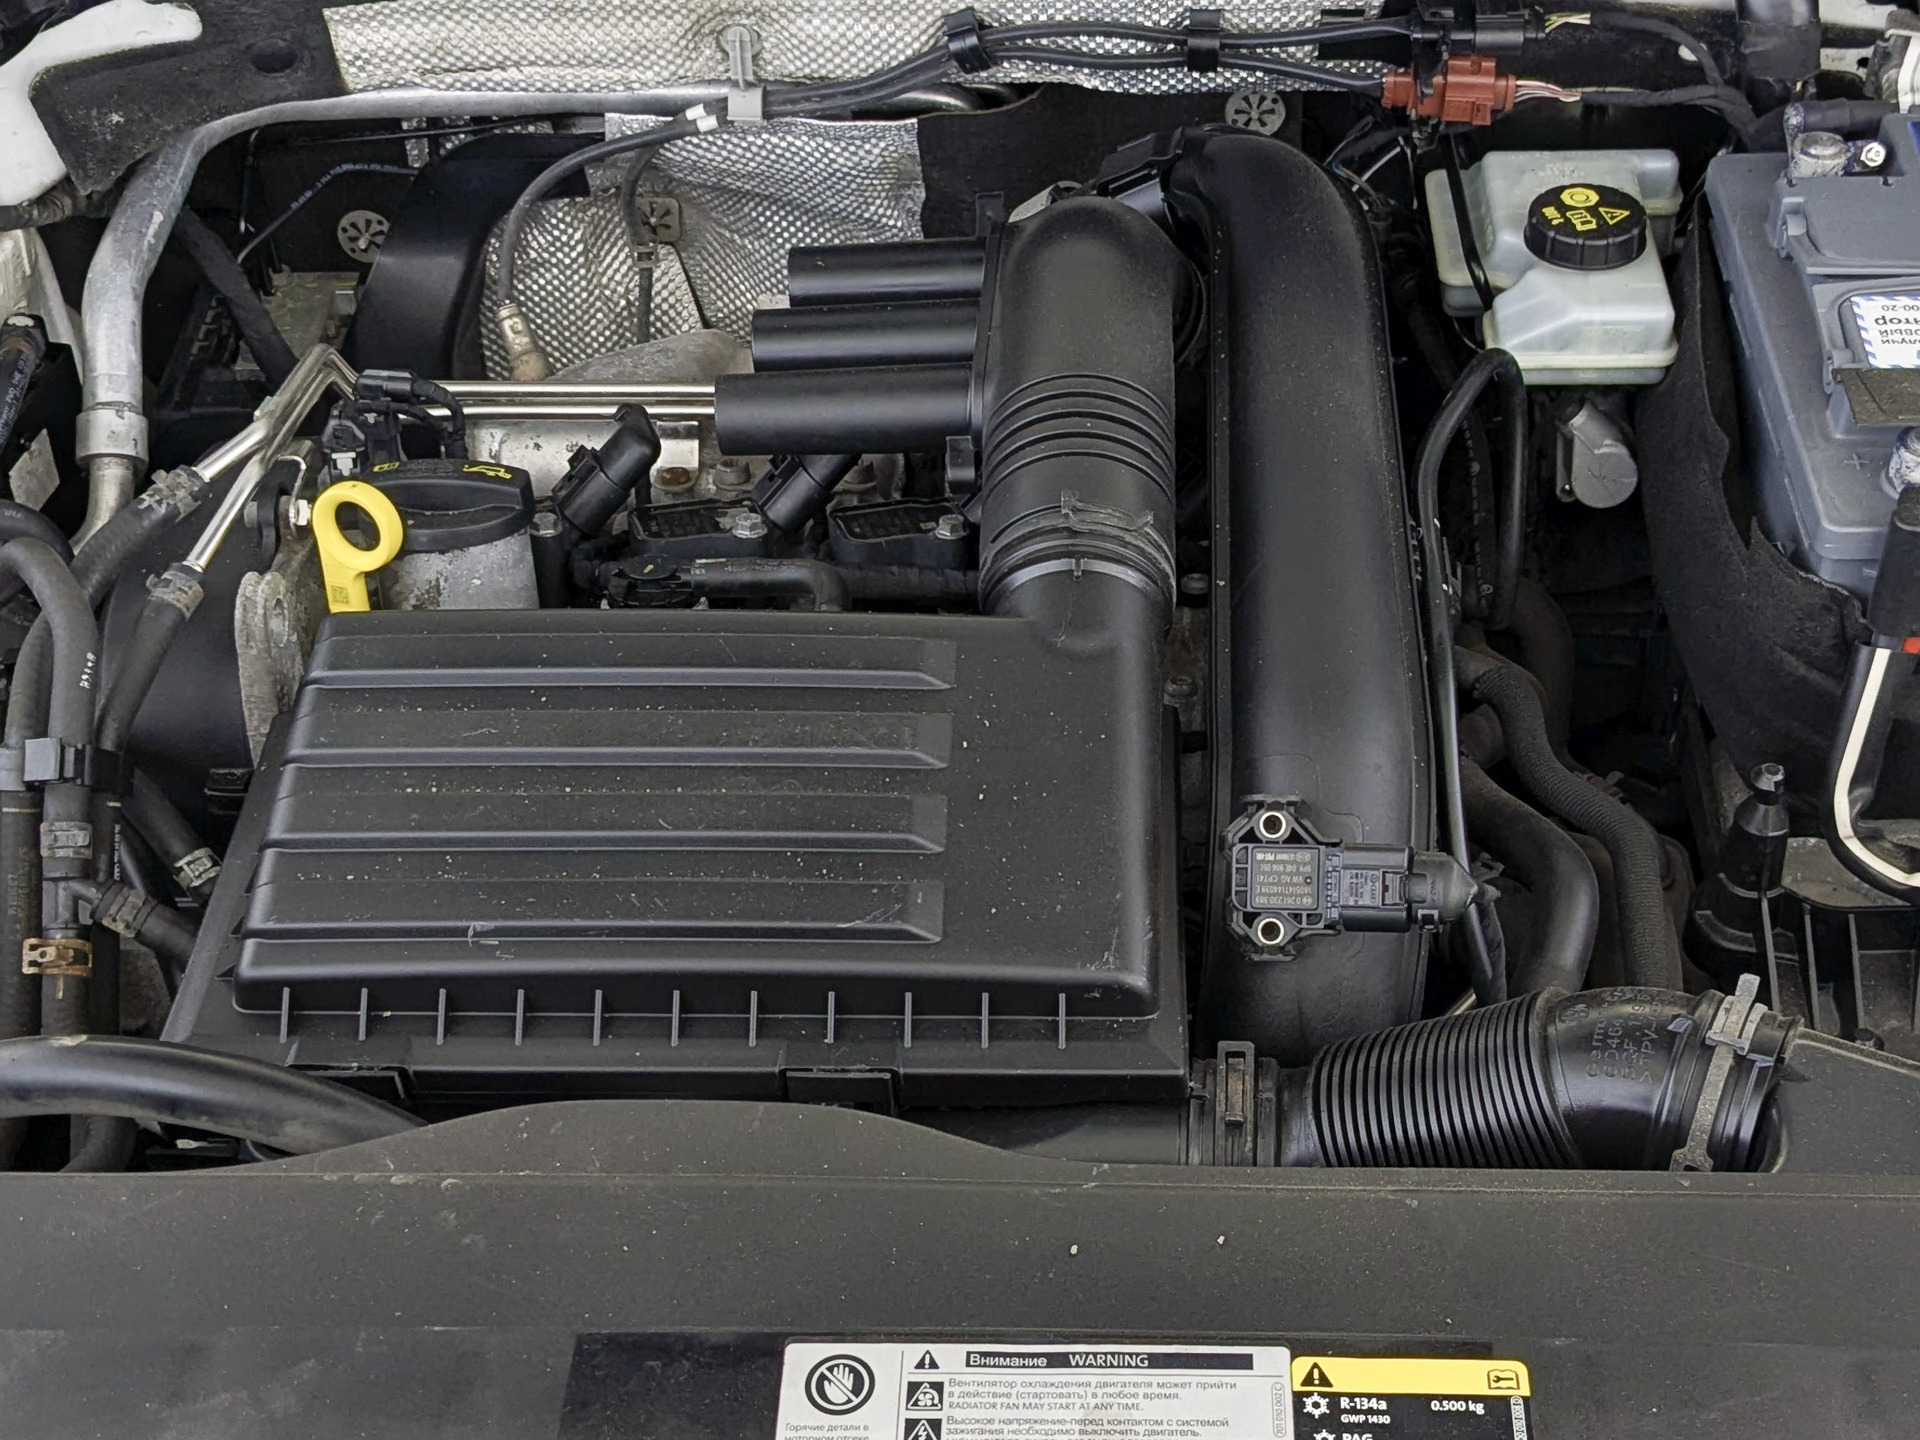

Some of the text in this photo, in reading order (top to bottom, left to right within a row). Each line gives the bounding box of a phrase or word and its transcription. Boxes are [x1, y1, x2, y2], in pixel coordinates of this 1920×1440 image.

[969, 1353, 1048, 1367] Внимание
[1068, 1353, 1149, 1367] WARNING
[948, 1378, 1236, 1391] Вентилятор охлаждения двигателя может прийти
[948, 1390, 1182, 1401] в действие (стартовать) в любое время.
[948, 1402, 1144, 1411] RADIATOR FAN MAY START AT ANY TIME.
[1340, 1397, 1485, 1415] R-134a 0.500 kg
[946, 1415, 995, 1426] Высокое
[1107, 1418, 1164, 1427] контактом
[1176, 1417, 1229, 1427] системой
[1340, 1414, 1391, 1424] GWP 1430
[785, 1423, 826, 1433] Горячие
[826, 1424, 860, 1432] детали
[945, 1427, 1004, 1436] зажигания
[1007, 1426, 1075, 1436] необходимо
[1078, 1427, 1140, 1436] выключить
